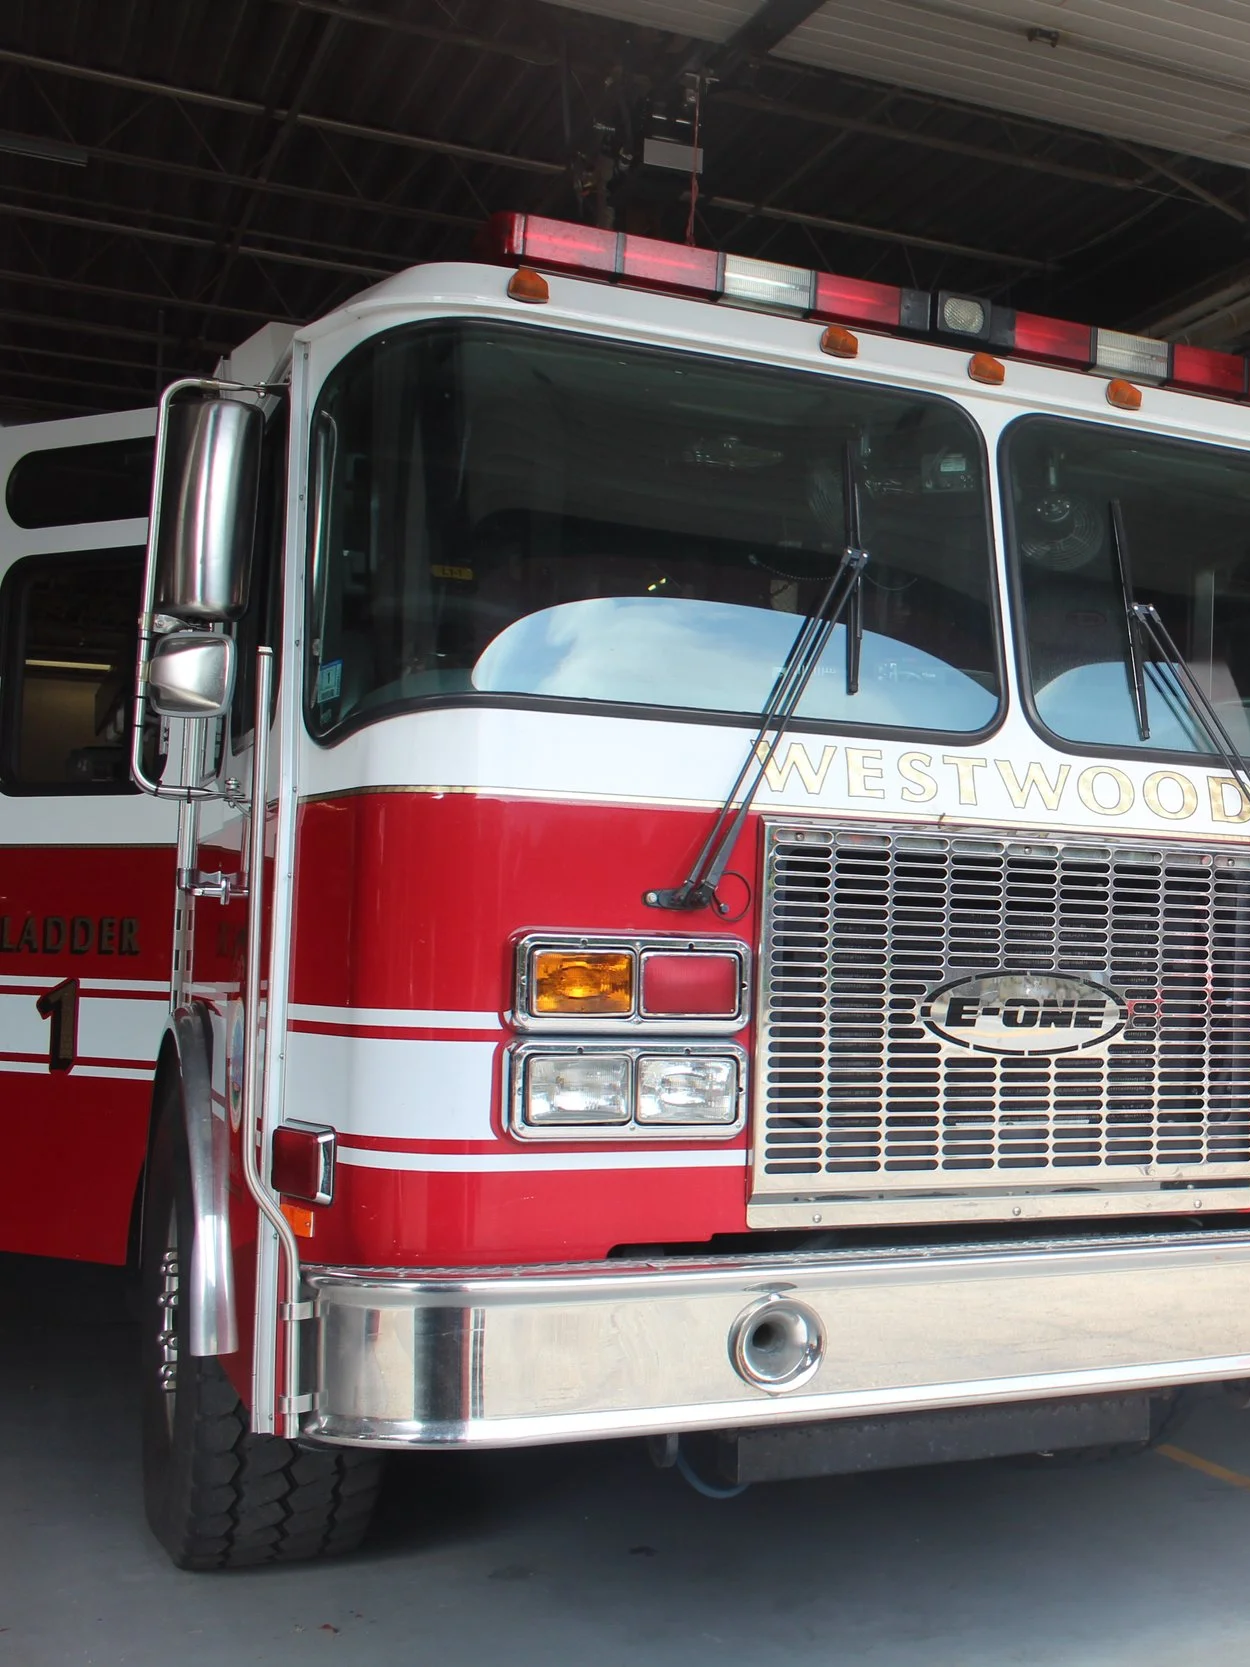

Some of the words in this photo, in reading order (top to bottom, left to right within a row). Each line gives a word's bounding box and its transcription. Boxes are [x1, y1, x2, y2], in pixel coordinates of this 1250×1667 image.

[0, 915, 140, 956] LADDER
[36, 977, 80, 1075] 1
[945, 997, 1107, 1028] E-ONE
